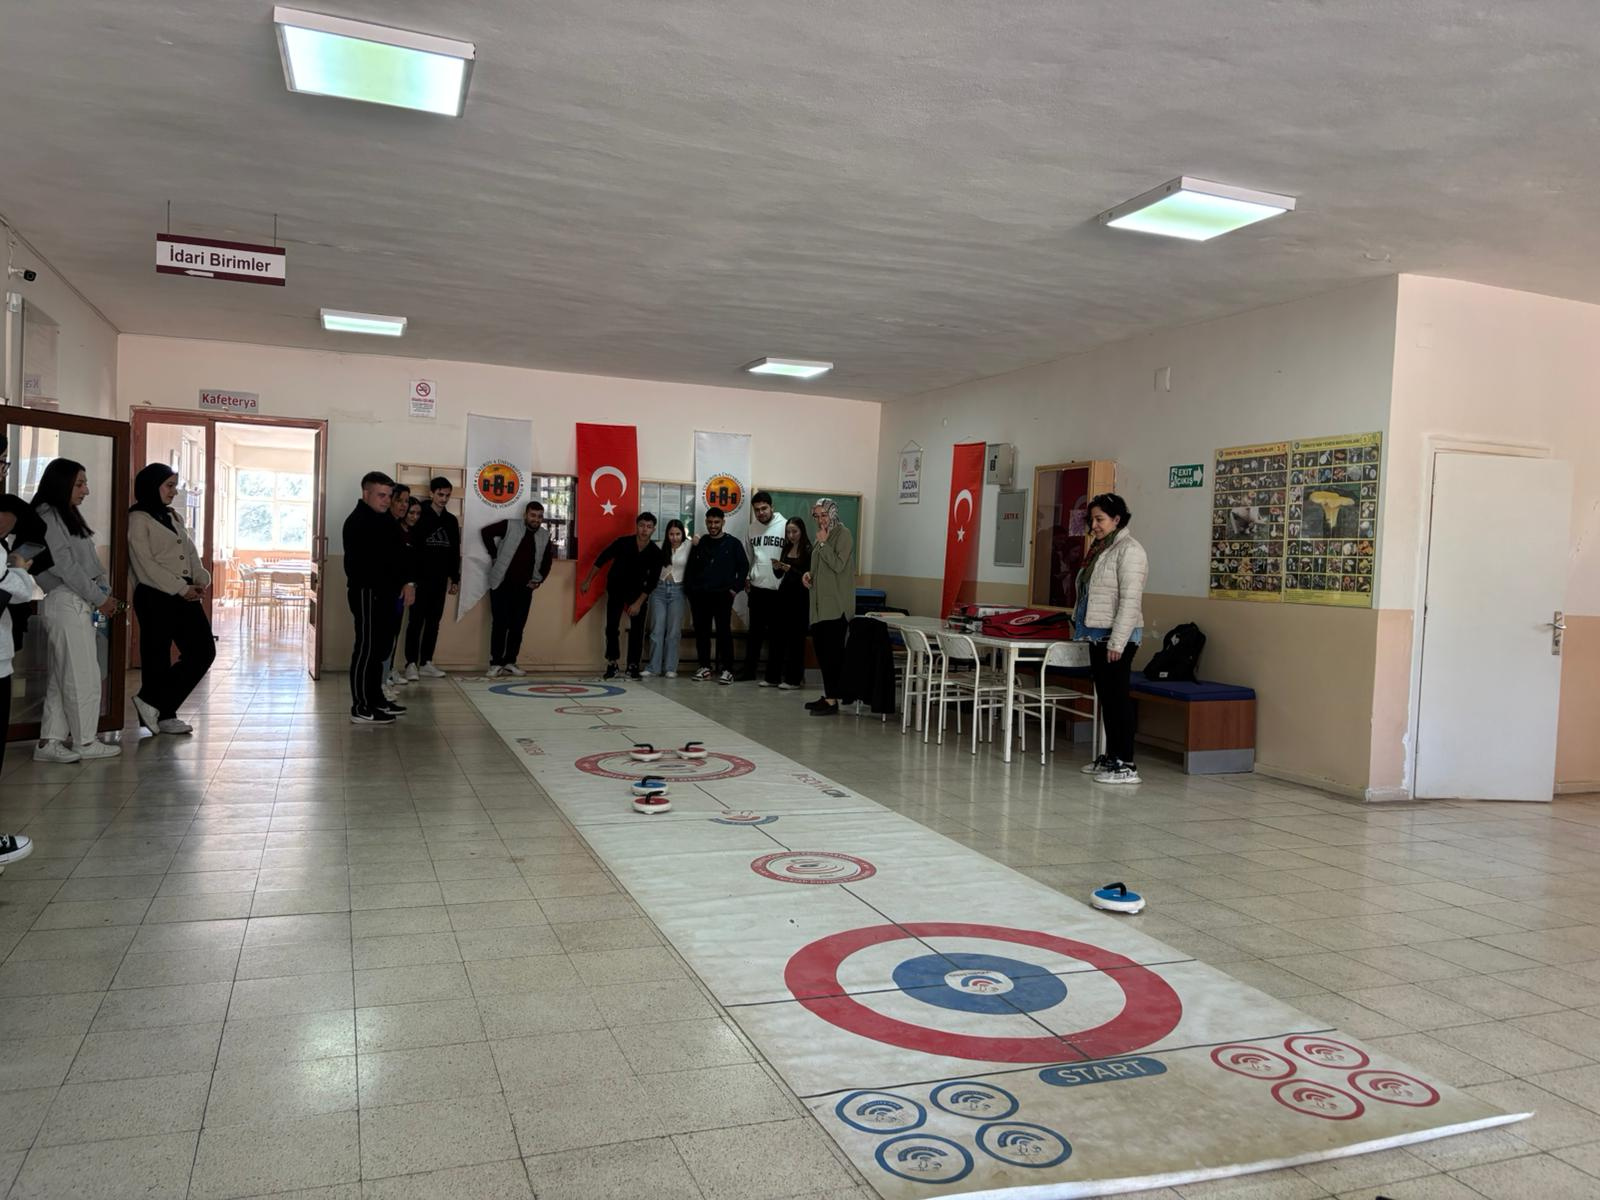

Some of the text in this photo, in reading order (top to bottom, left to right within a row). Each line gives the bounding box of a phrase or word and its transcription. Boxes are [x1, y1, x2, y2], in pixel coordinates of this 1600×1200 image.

[170, 245, 271, 272] İdari Birimler
[202, 393, 257, 409] Kafeterya
[1178, 467, 1193, 476] EXIT
[1177, 477, 1194, 487] ÇIKIŞ
[763, 535, 785, 548] DIEGO
[1057, 1060, 1148, 1083] START
